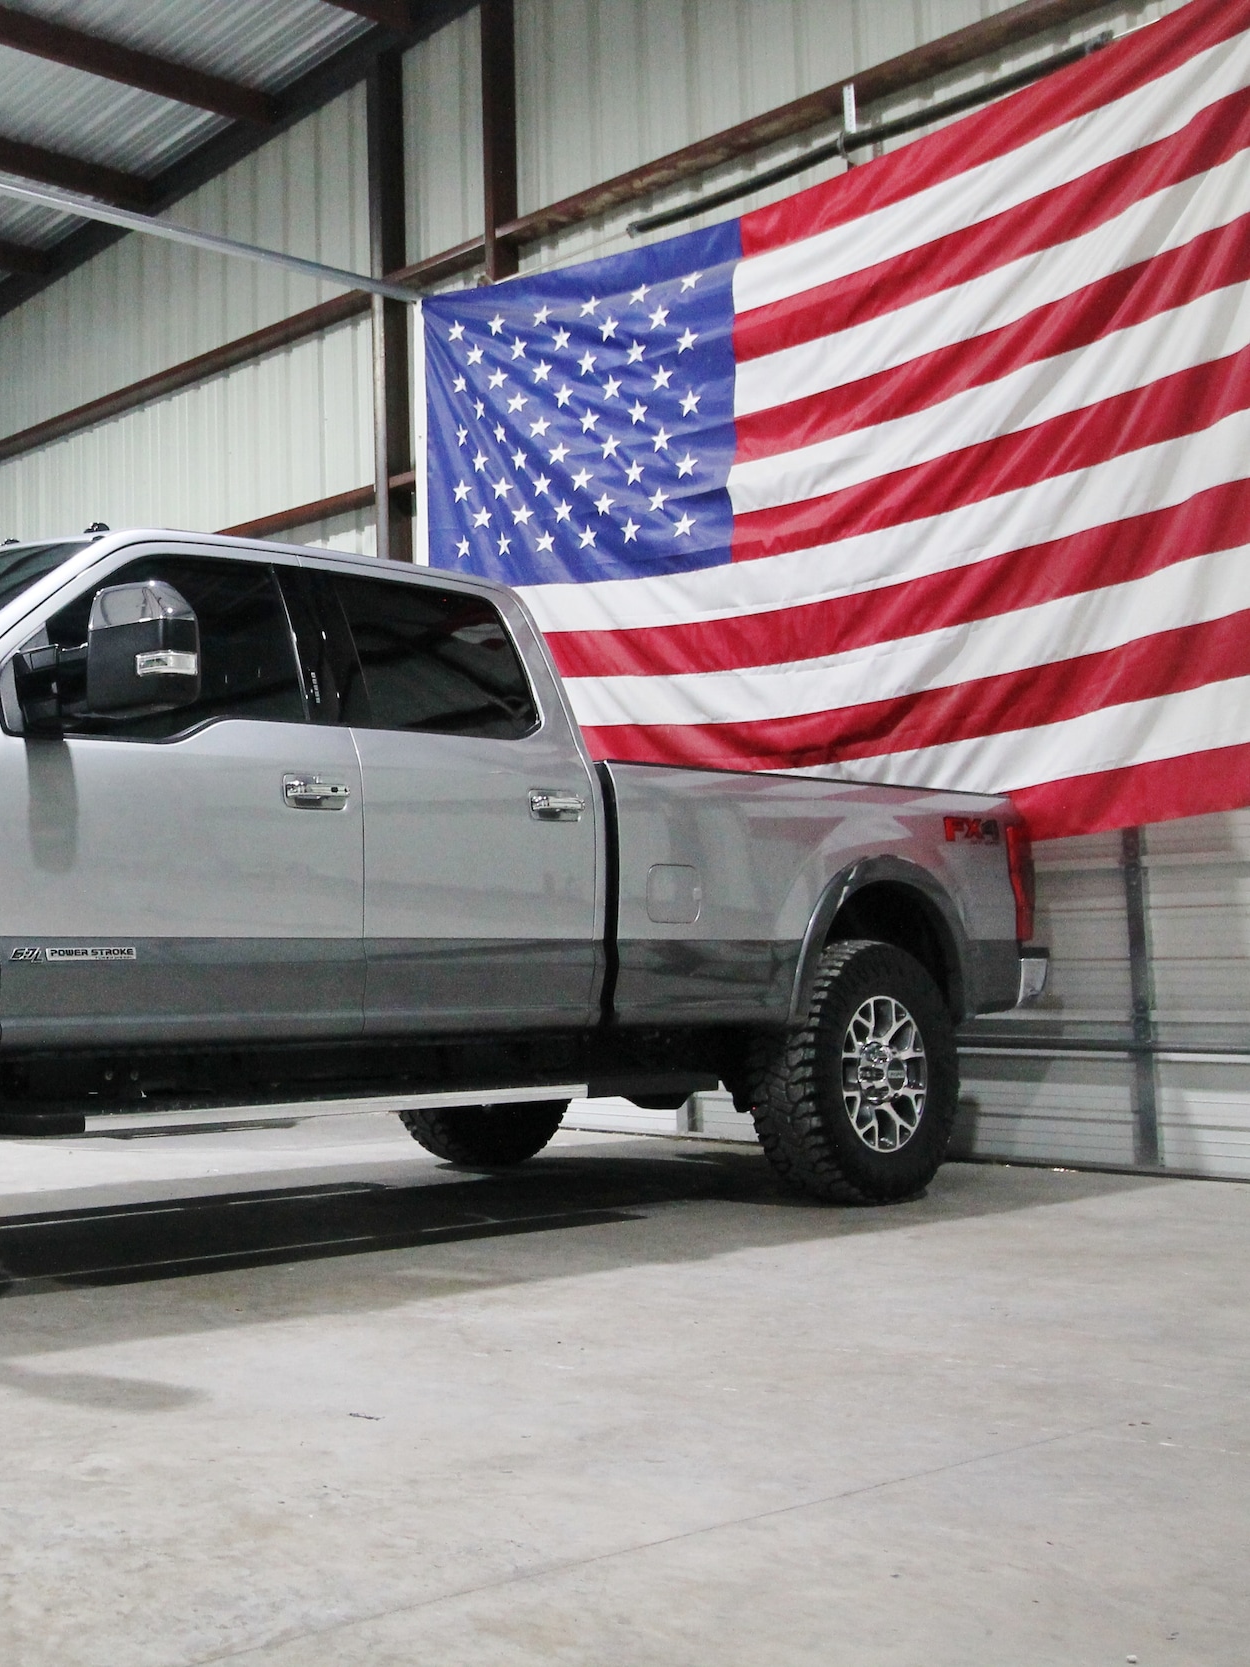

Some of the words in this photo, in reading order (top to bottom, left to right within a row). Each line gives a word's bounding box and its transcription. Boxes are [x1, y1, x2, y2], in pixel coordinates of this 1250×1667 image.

[943, 816, 1000, 842] FX4
[50, 949, 89, 957] POWER
[91, 948, 134, 956] STROKE
